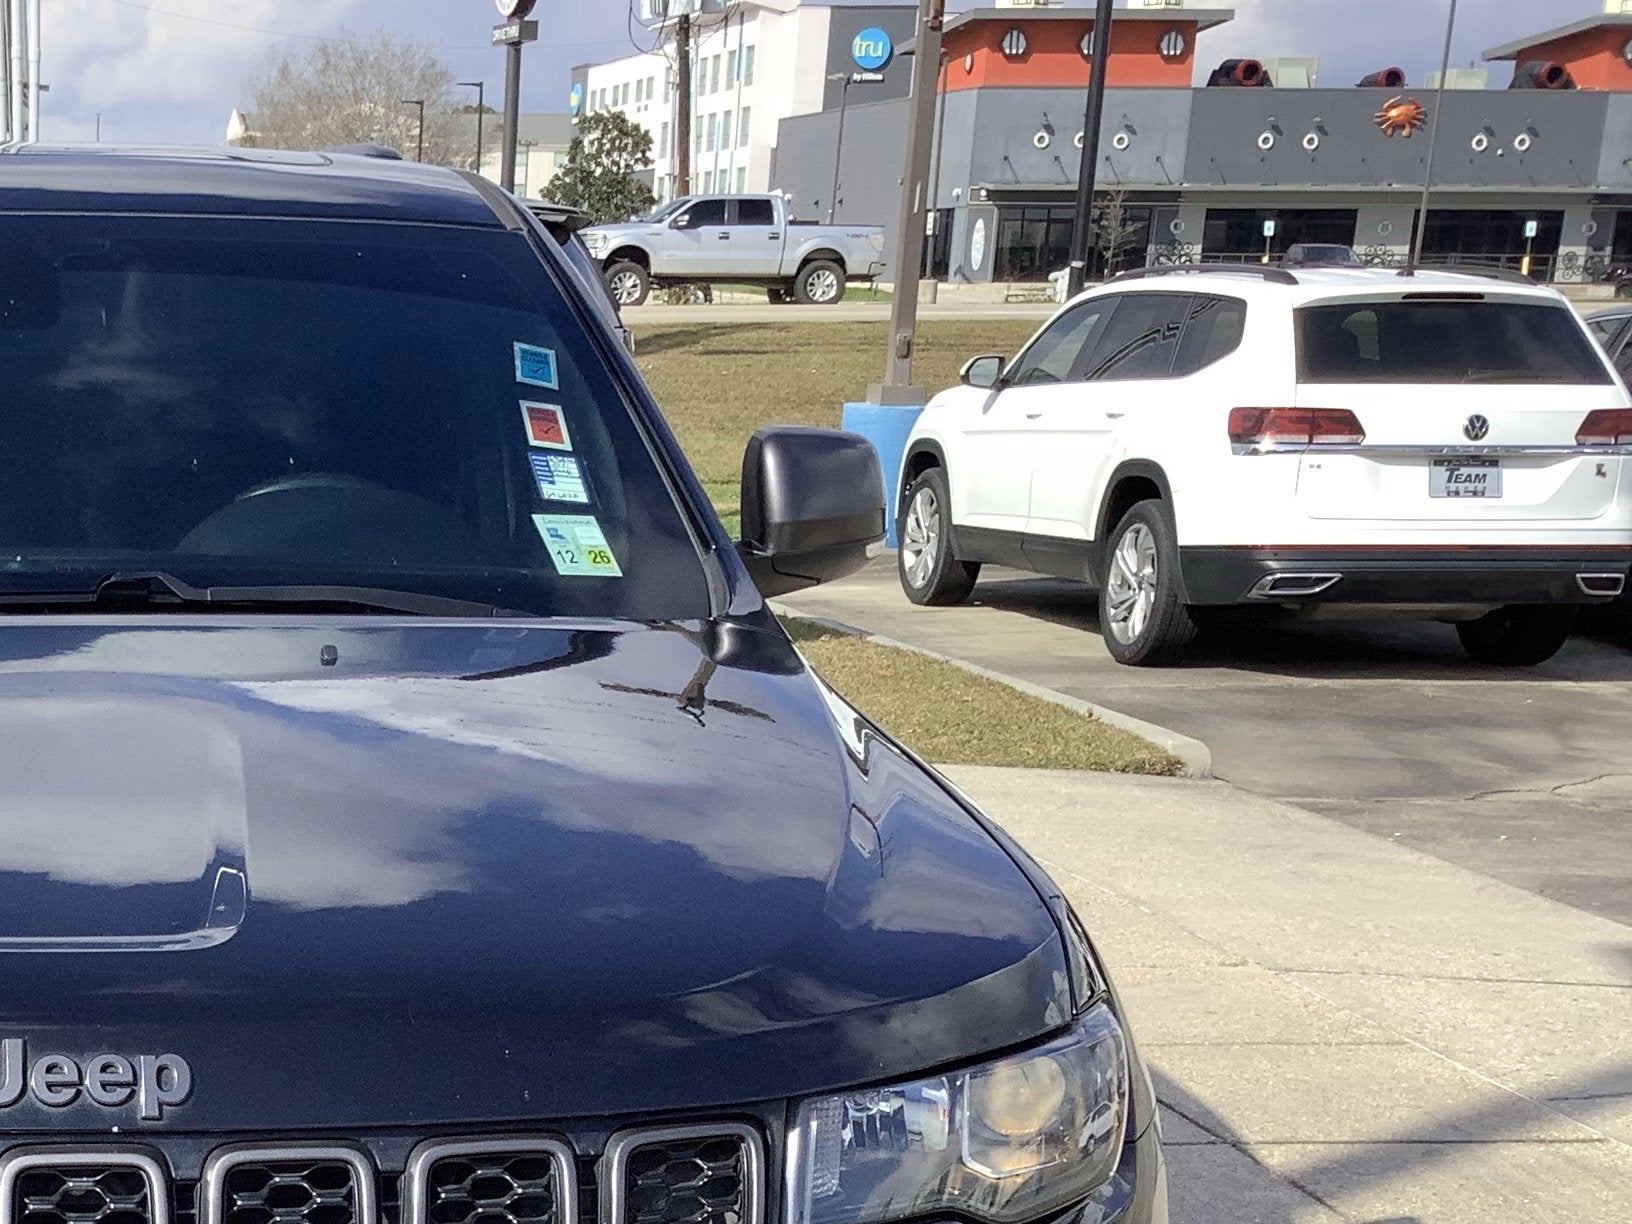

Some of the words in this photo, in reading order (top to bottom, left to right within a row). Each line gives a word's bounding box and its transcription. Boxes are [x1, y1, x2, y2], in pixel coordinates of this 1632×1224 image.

[854, 37, 884, 58] tru
[556, 549, 579, 565] 12
[588, 550, 611, 565] 26
